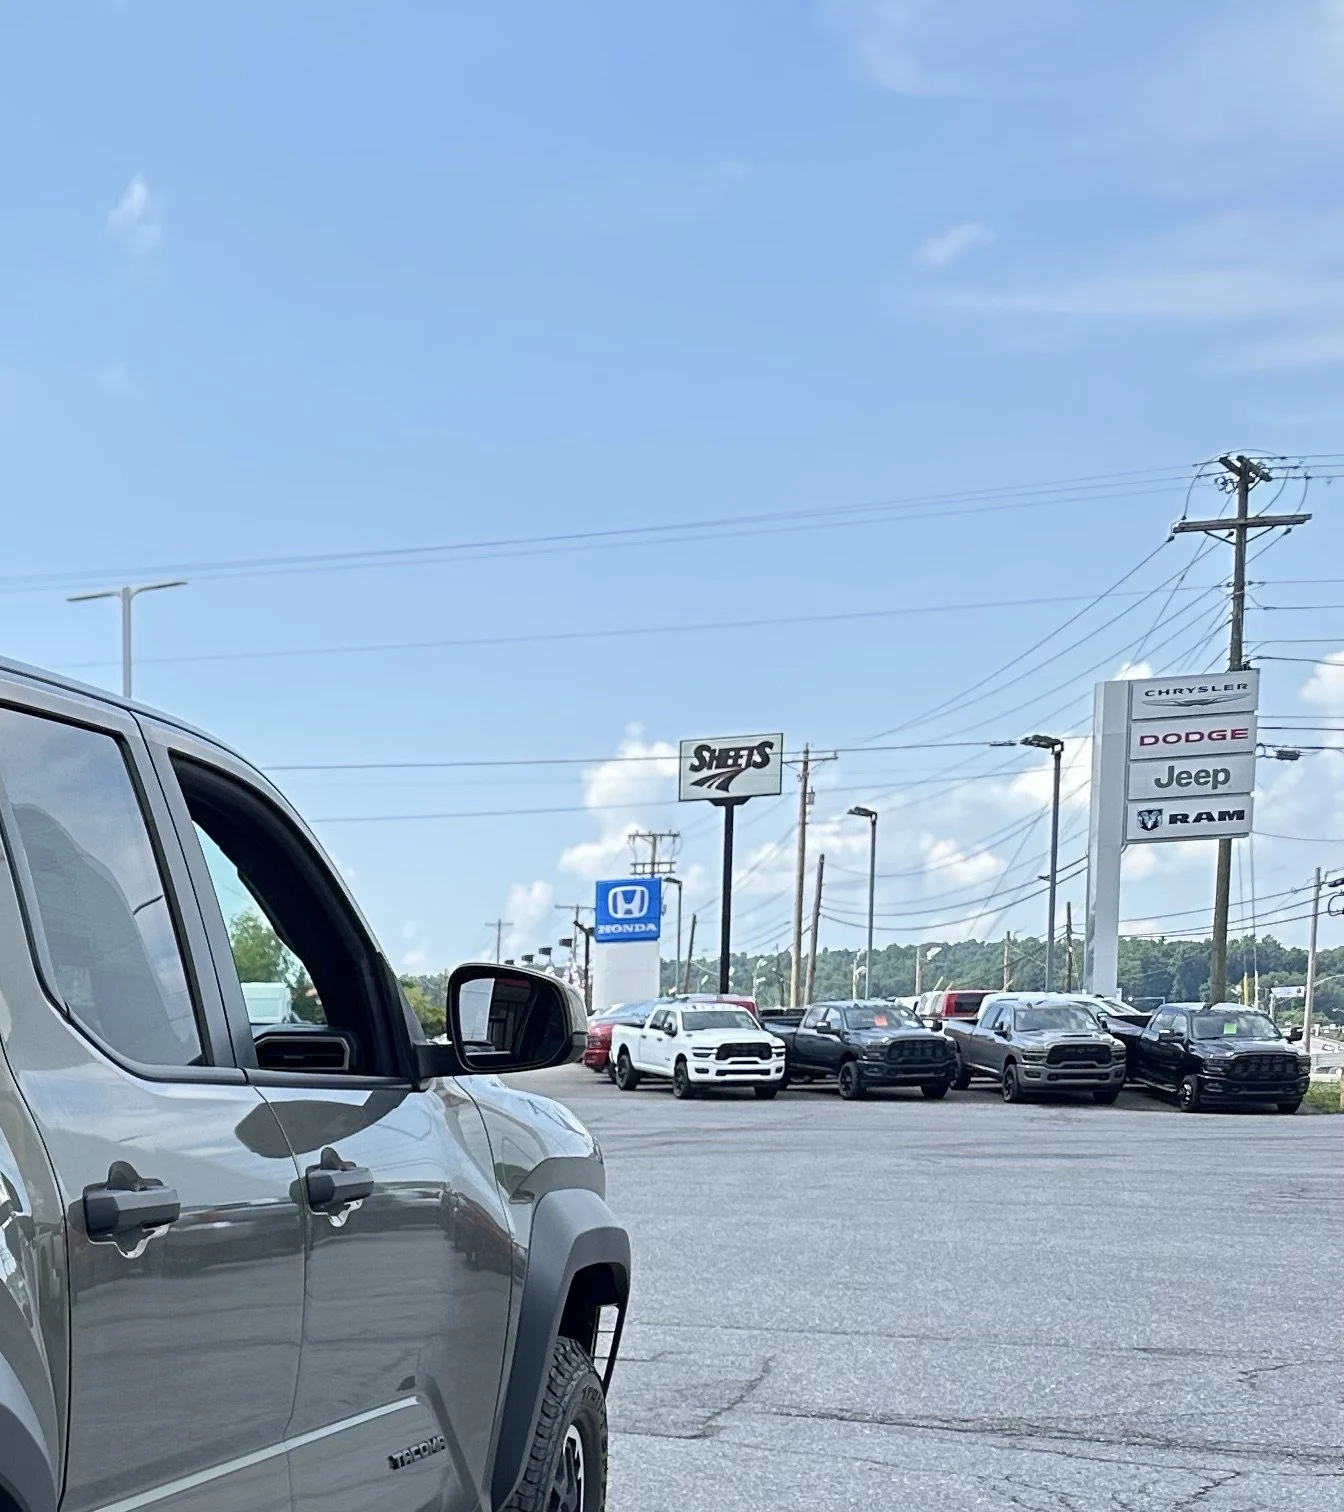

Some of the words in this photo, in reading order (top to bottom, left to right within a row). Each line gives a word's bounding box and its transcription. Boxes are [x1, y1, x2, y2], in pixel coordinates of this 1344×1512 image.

[1144, 683, 1249, 697] CHRYSLER
[1139, 728, 1250, 747] DODGE
[1154, 765, 1231, 790] Jeep
[1168, 809, 1246, 825] RAM
[597, 922, 658, 934] HONDA
